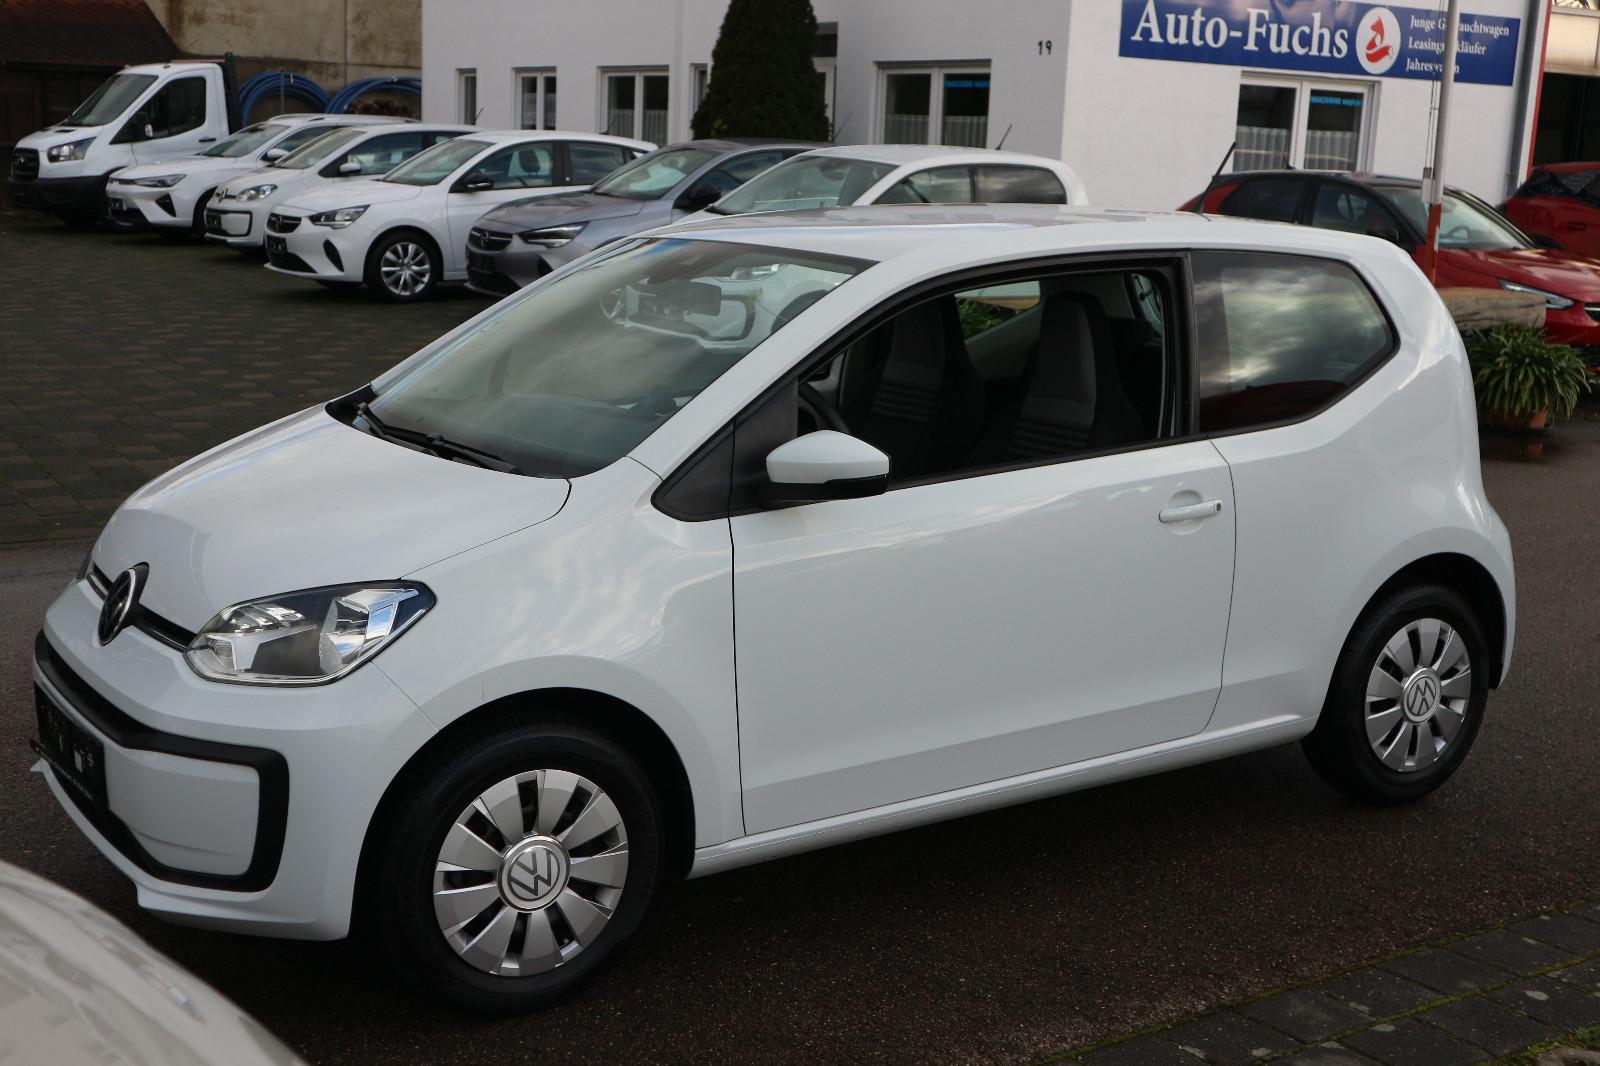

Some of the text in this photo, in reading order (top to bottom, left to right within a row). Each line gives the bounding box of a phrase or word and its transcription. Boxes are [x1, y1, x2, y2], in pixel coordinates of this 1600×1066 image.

[1131, 0, 1348, 58] Auto-Fuchs
[1410, 15, 1509, 38] Junge Gauchtwagen
[1037, 40, 1052, 55] 19
[1408, 36, 1487, 55] Leasingrkläufer
[1406, 58, 1460, 74] Jahreswan
